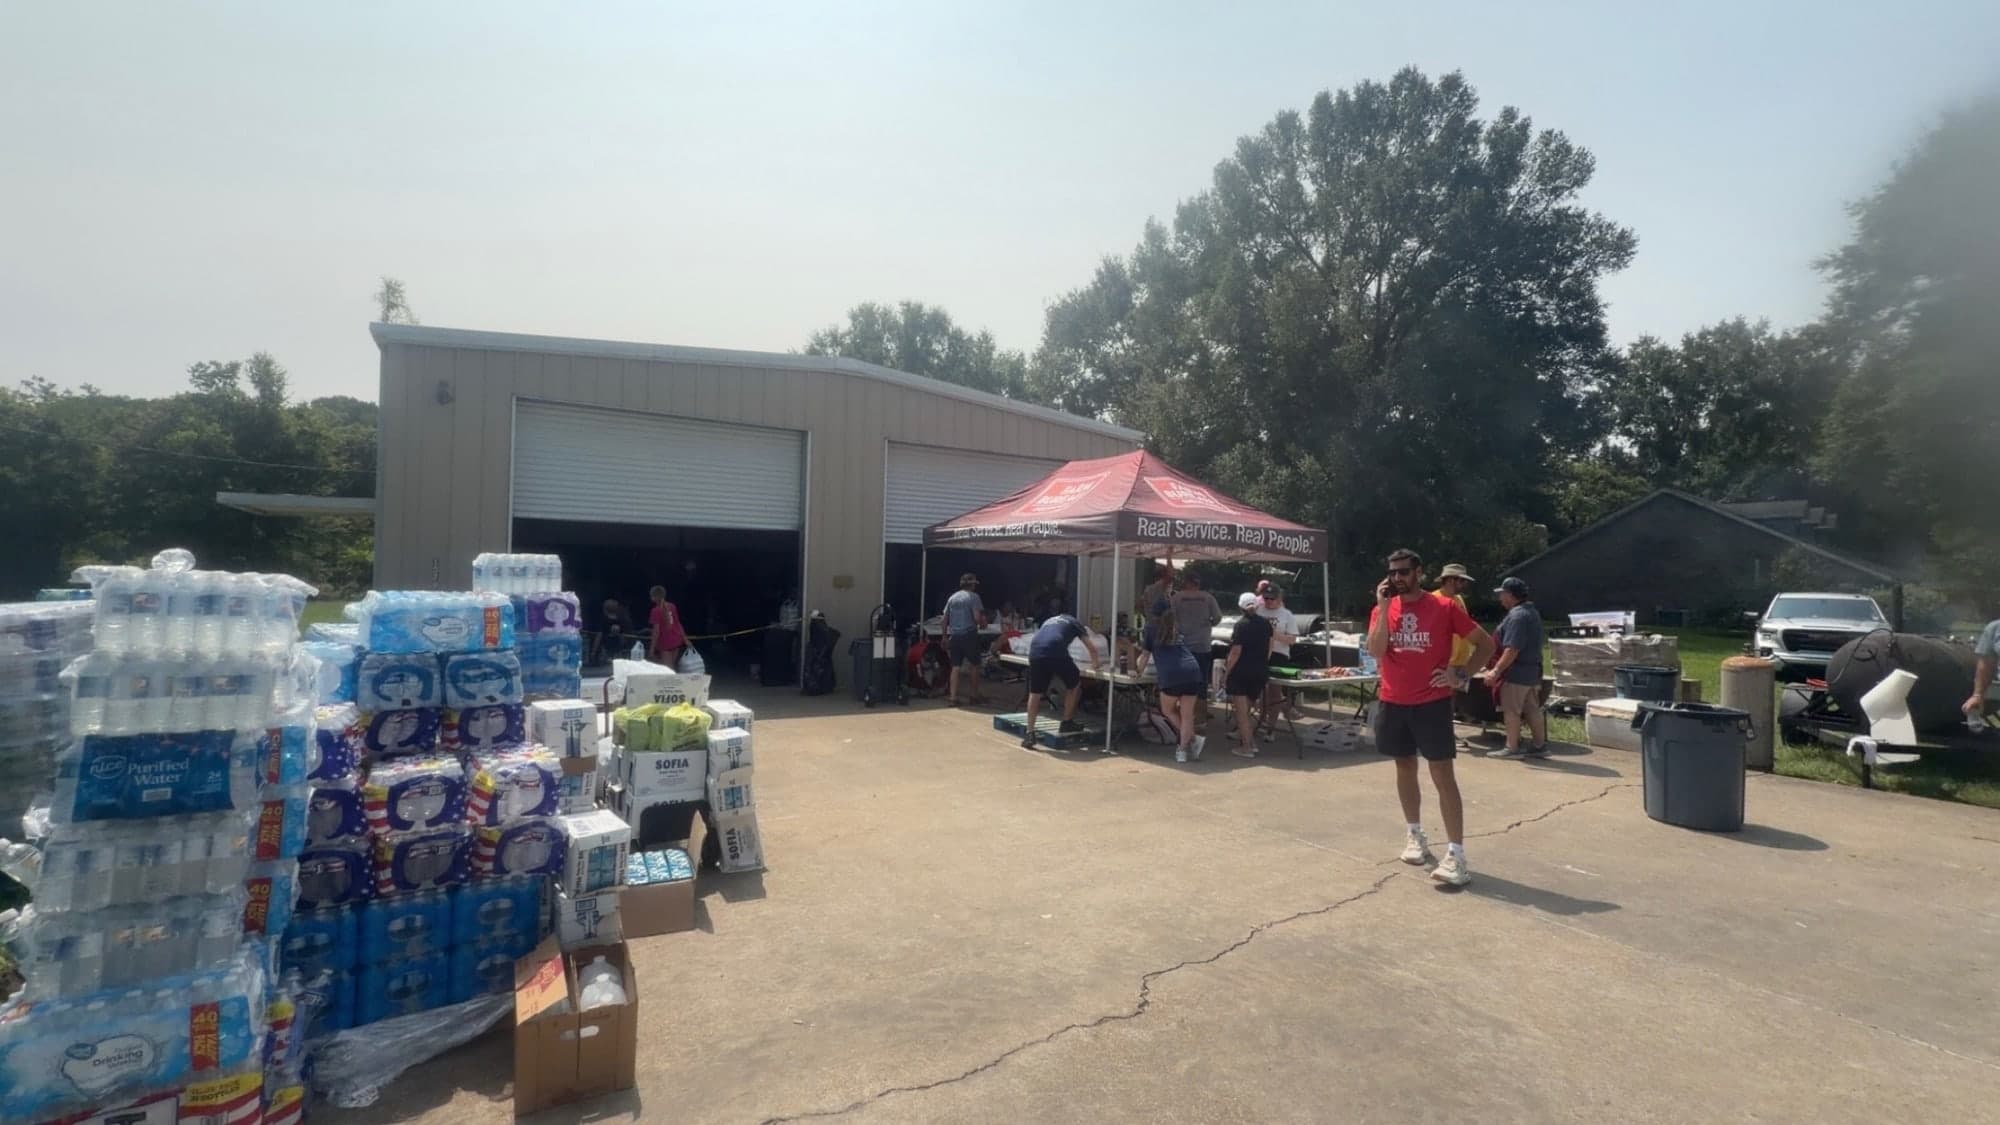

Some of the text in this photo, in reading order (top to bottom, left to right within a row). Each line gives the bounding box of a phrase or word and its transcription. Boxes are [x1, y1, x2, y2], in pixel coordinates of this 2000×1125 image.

[1137, 517, 1170, 537] Real
[1175, 520, 1231, 541] Service.
[1236, 524, 1265, 545] Real
[128, 757, 189, 775] Purified
[656, 758, 689, 769] SOFIA
[134, 774, 181, 786] Water
[725, 828, 740, 860] SOFIA
